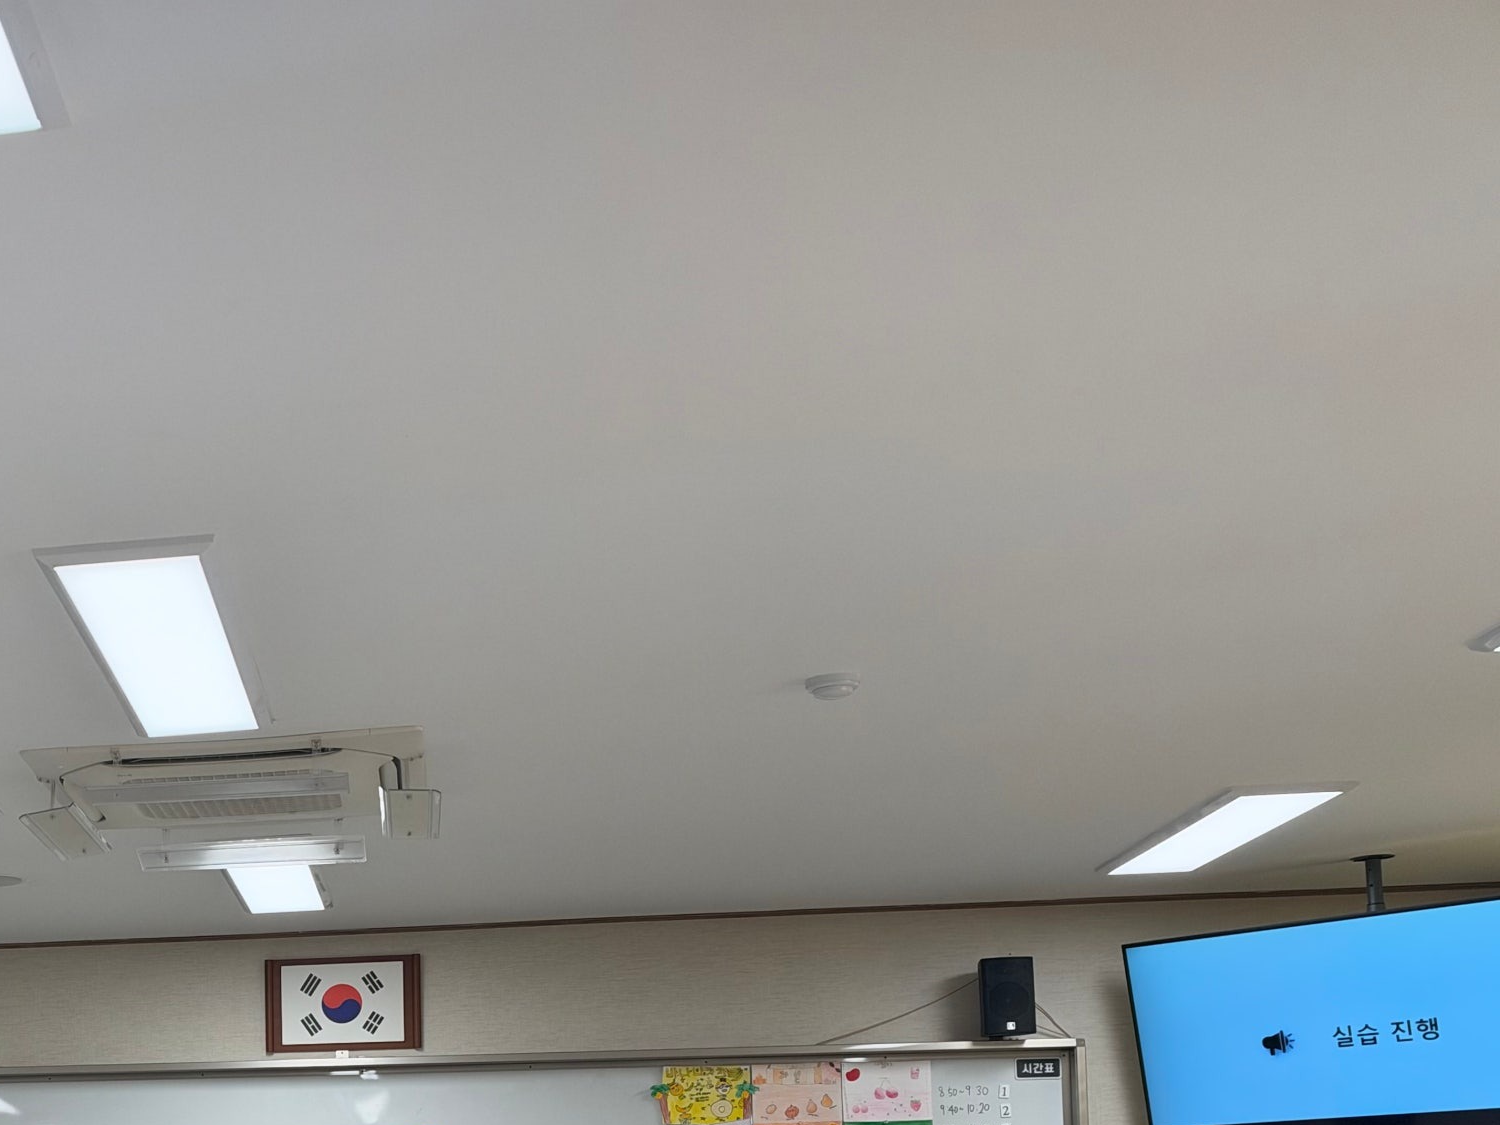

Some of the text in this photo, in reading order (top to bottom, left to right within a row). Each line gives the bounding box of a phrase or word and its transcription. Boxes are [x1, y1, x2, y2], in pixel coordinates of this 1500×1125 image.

[1332, 1017, 1440, 1048] 실습 진행
[1021, 1062, 1055, 1074] 시간표
